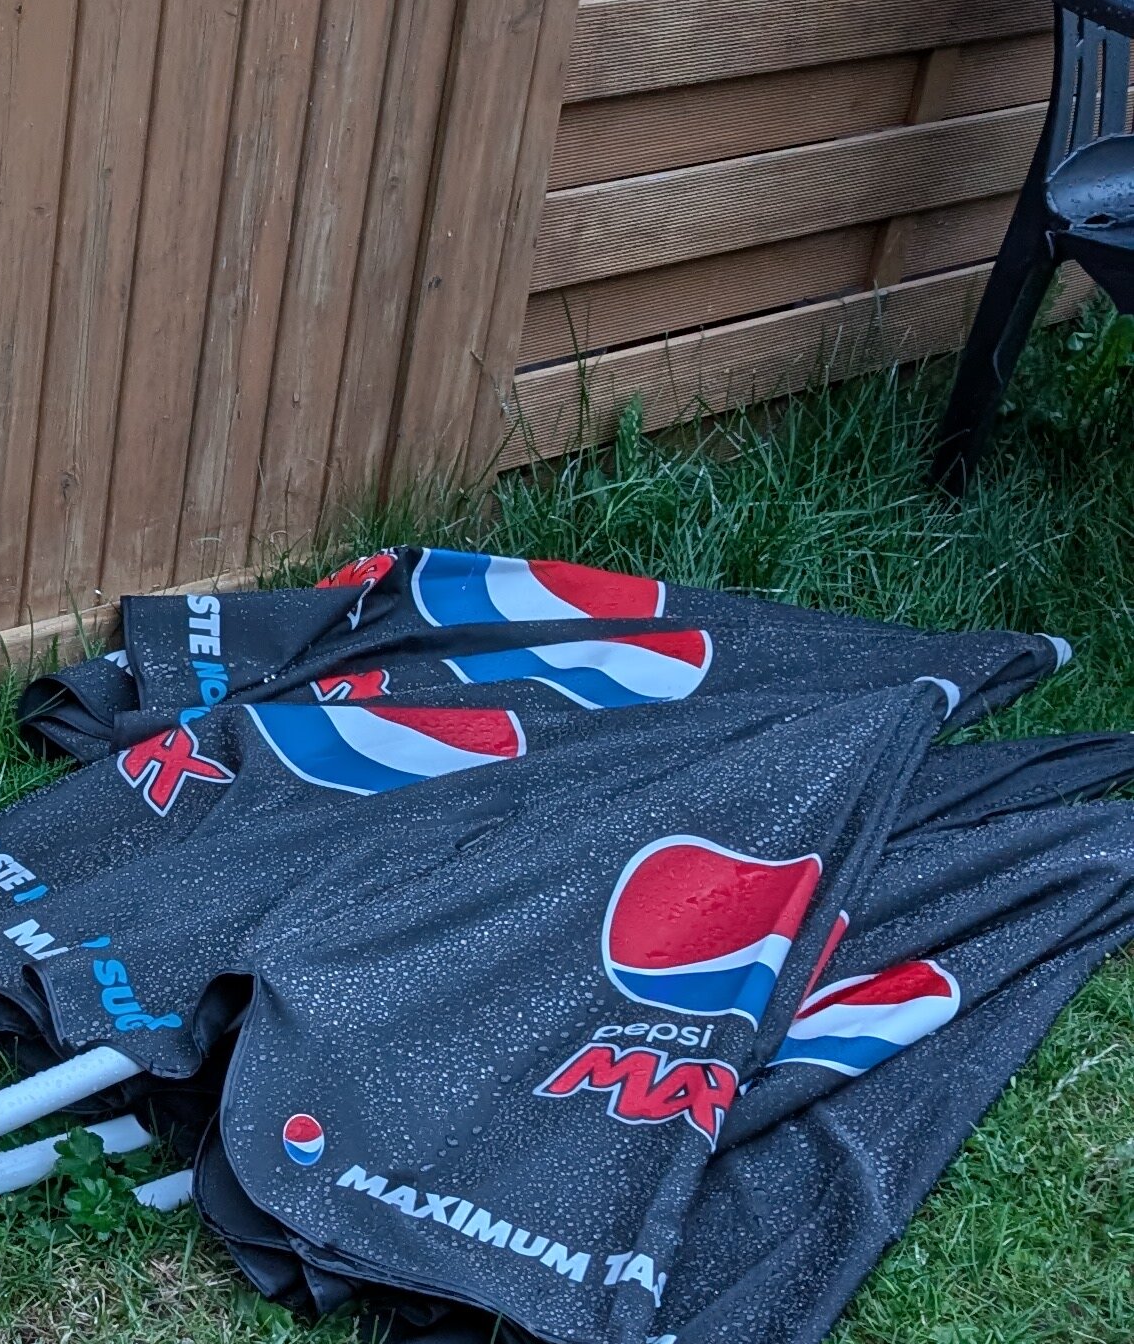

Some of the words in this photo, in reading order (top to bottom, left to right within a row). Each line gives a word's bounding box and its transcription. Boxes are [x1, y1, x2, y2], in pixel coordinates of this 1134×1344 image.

[187, 594, 221, 656] STE
[591, 1022, 715, 1048] pepsi
[532, 1042, 739, 1153] MAX
[336, 1164, 591, 1283] MAXIMUM
